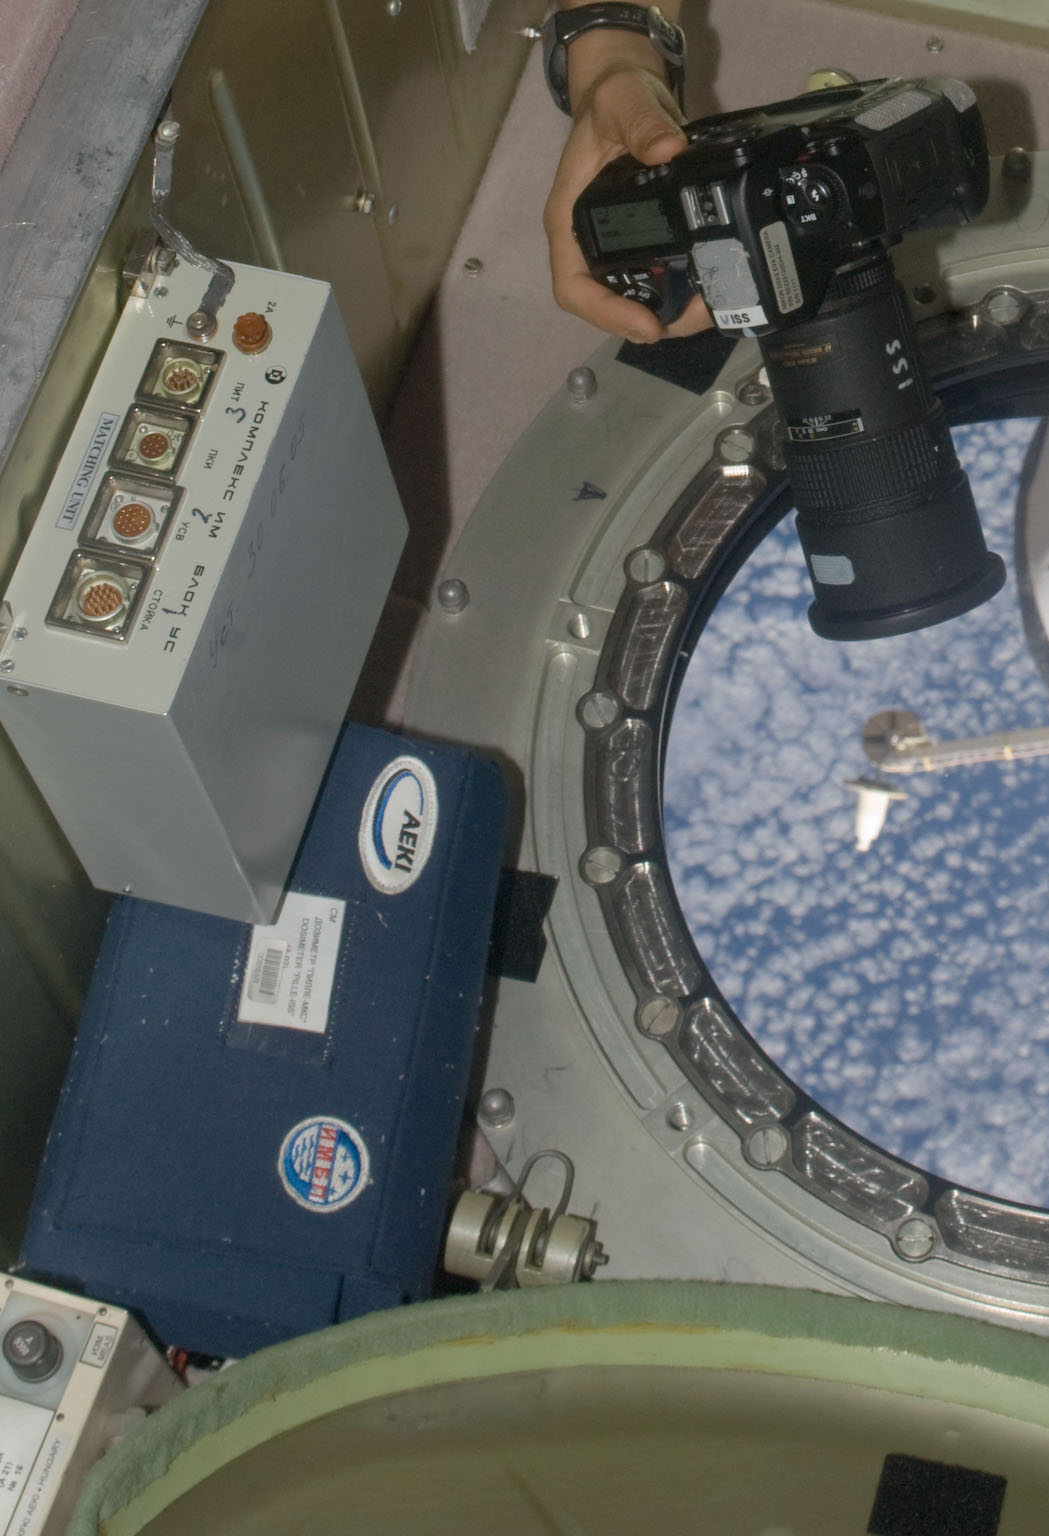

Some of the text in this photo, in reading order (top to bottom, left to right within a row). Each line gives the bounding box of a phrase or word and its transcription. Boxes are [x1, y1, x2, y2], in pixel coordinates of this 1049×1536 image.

[231, 382, 245, 403] ПИТ
[63, 418, 115, 525] MATCHING UNIT
[223, 400, 270, 502] КОМПЛЕКС
[139, 589, 163, 631] СТОЙКА
[177, 564, 205, 616] БЛОК
[394, 808, 421, 874] AEKI
[294, 917, 310, 969] DOSIMETER
[308, 1126, 337, 1199] ИМБП
[38, 1439, 62, 1487] HUNGARY
